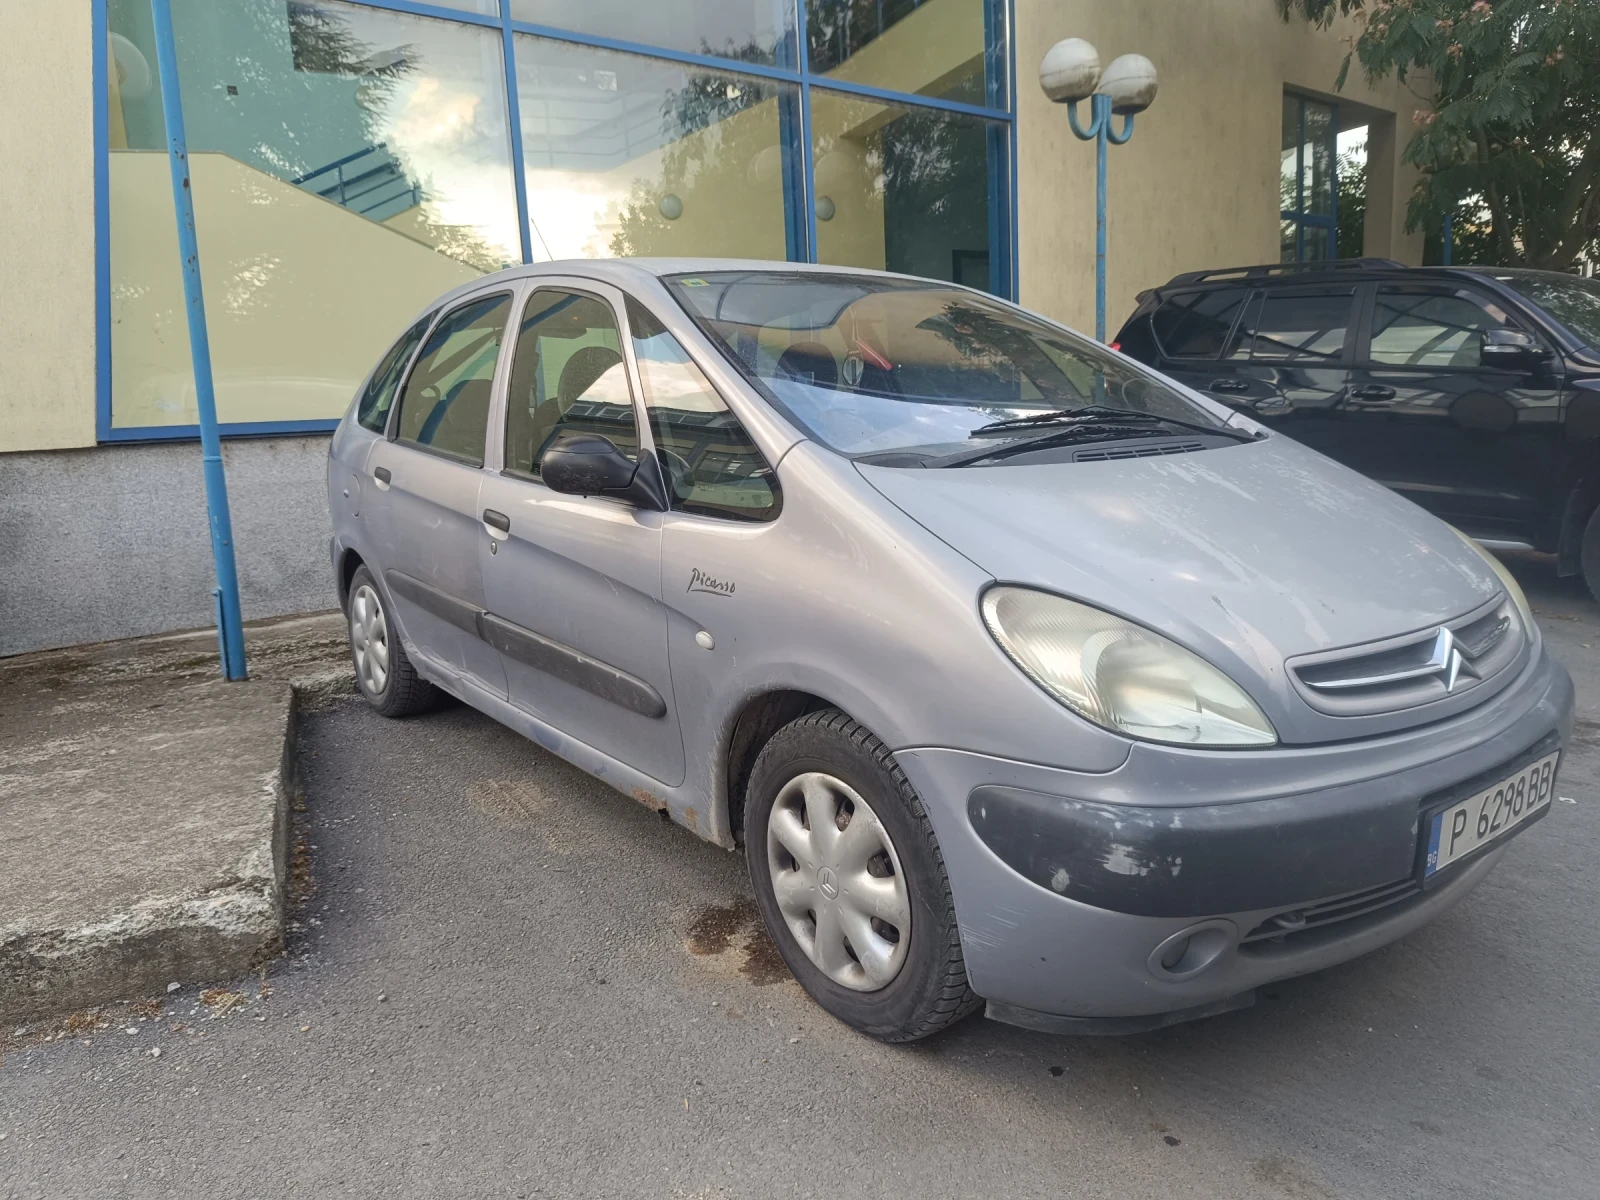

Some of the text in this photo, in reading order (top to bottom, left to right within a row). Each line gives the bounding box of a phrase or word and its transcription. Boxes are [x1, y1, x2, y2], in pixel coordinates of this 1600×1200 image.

[686, 567, 735, 594] Picasso
[1449, 808, 1467, 857] P
[1427, 850, 1437, 867] BG
